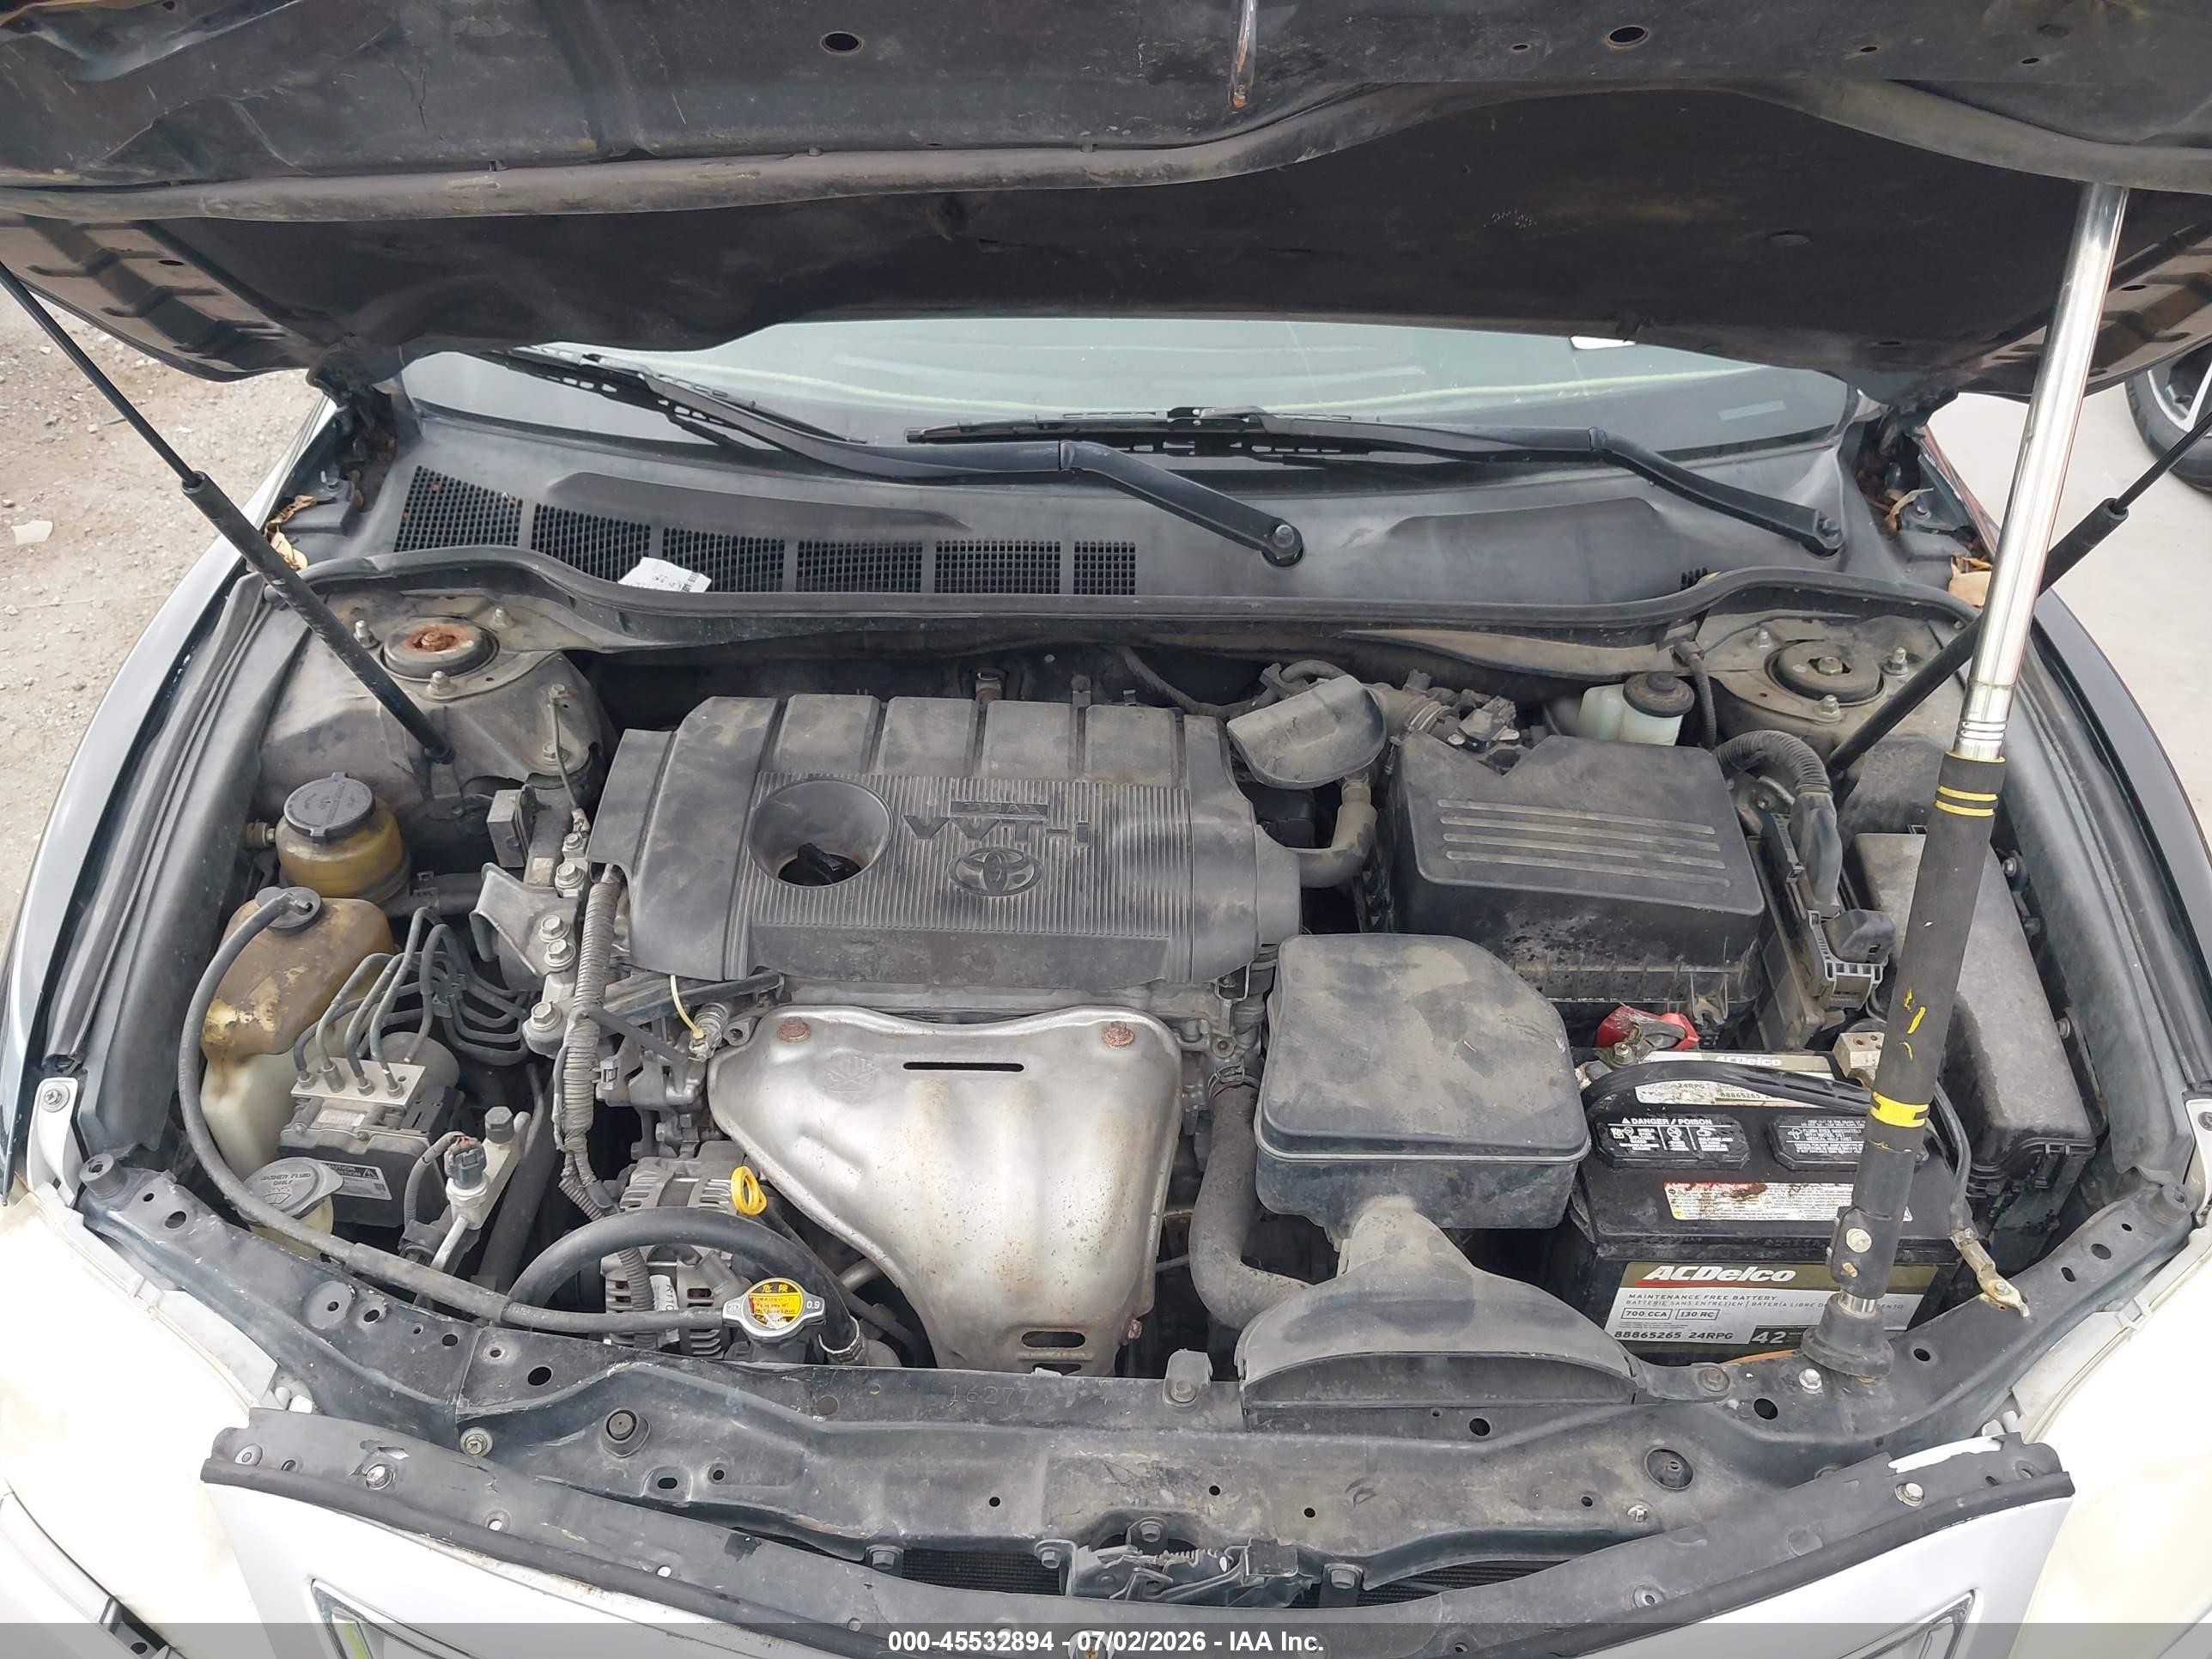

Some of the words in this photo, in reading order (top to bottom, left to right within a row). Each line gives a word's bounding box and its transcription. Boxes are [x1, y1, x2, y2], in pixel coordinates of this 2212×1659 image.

[1642, 1266, 1796, 1282] ACDelco
[805, 1300, 821, 1310] 0.9
[1613, 1331, 1681, 1340] 88865265
[1751, 1331, 1787, 1344] 42
